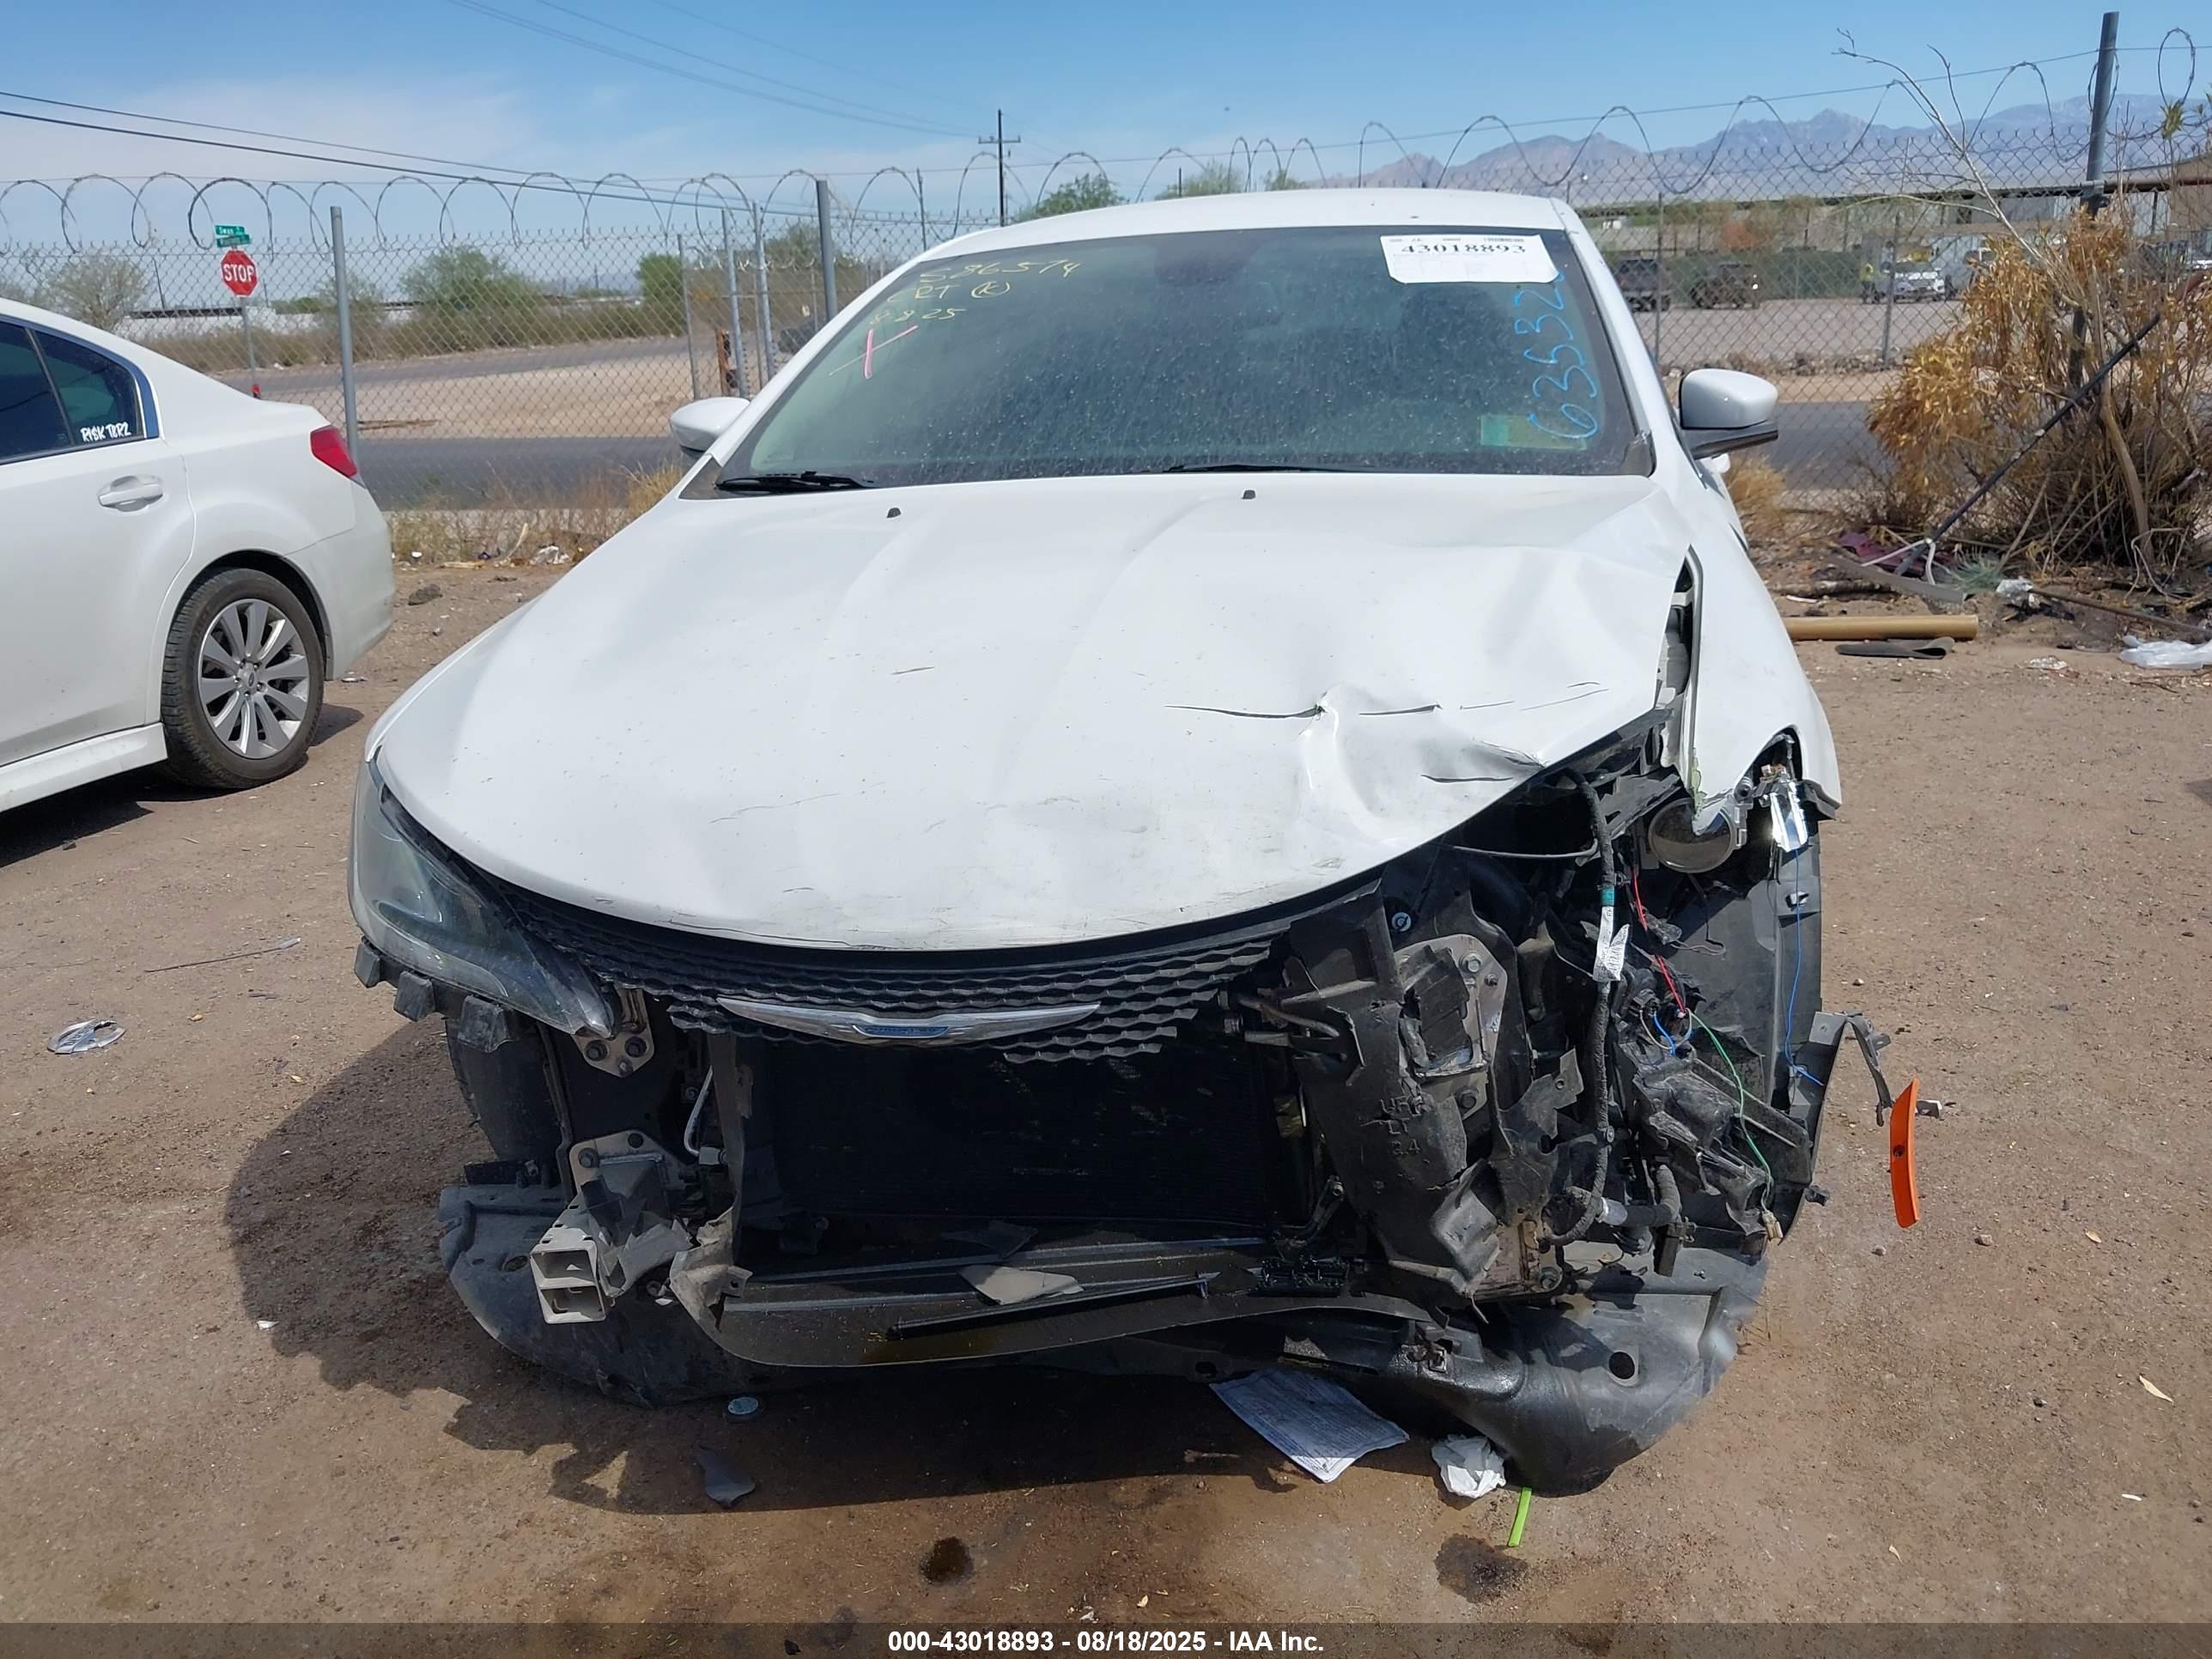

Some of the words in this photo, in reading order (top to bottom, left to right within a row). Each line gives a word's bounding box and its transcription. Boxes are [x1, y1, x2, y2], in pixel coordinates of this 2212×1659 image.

[1401, 243, 1527, 254] 43018893
[223, 263, 255, 283] STOP
[80, 425, 106, 442] RISK
